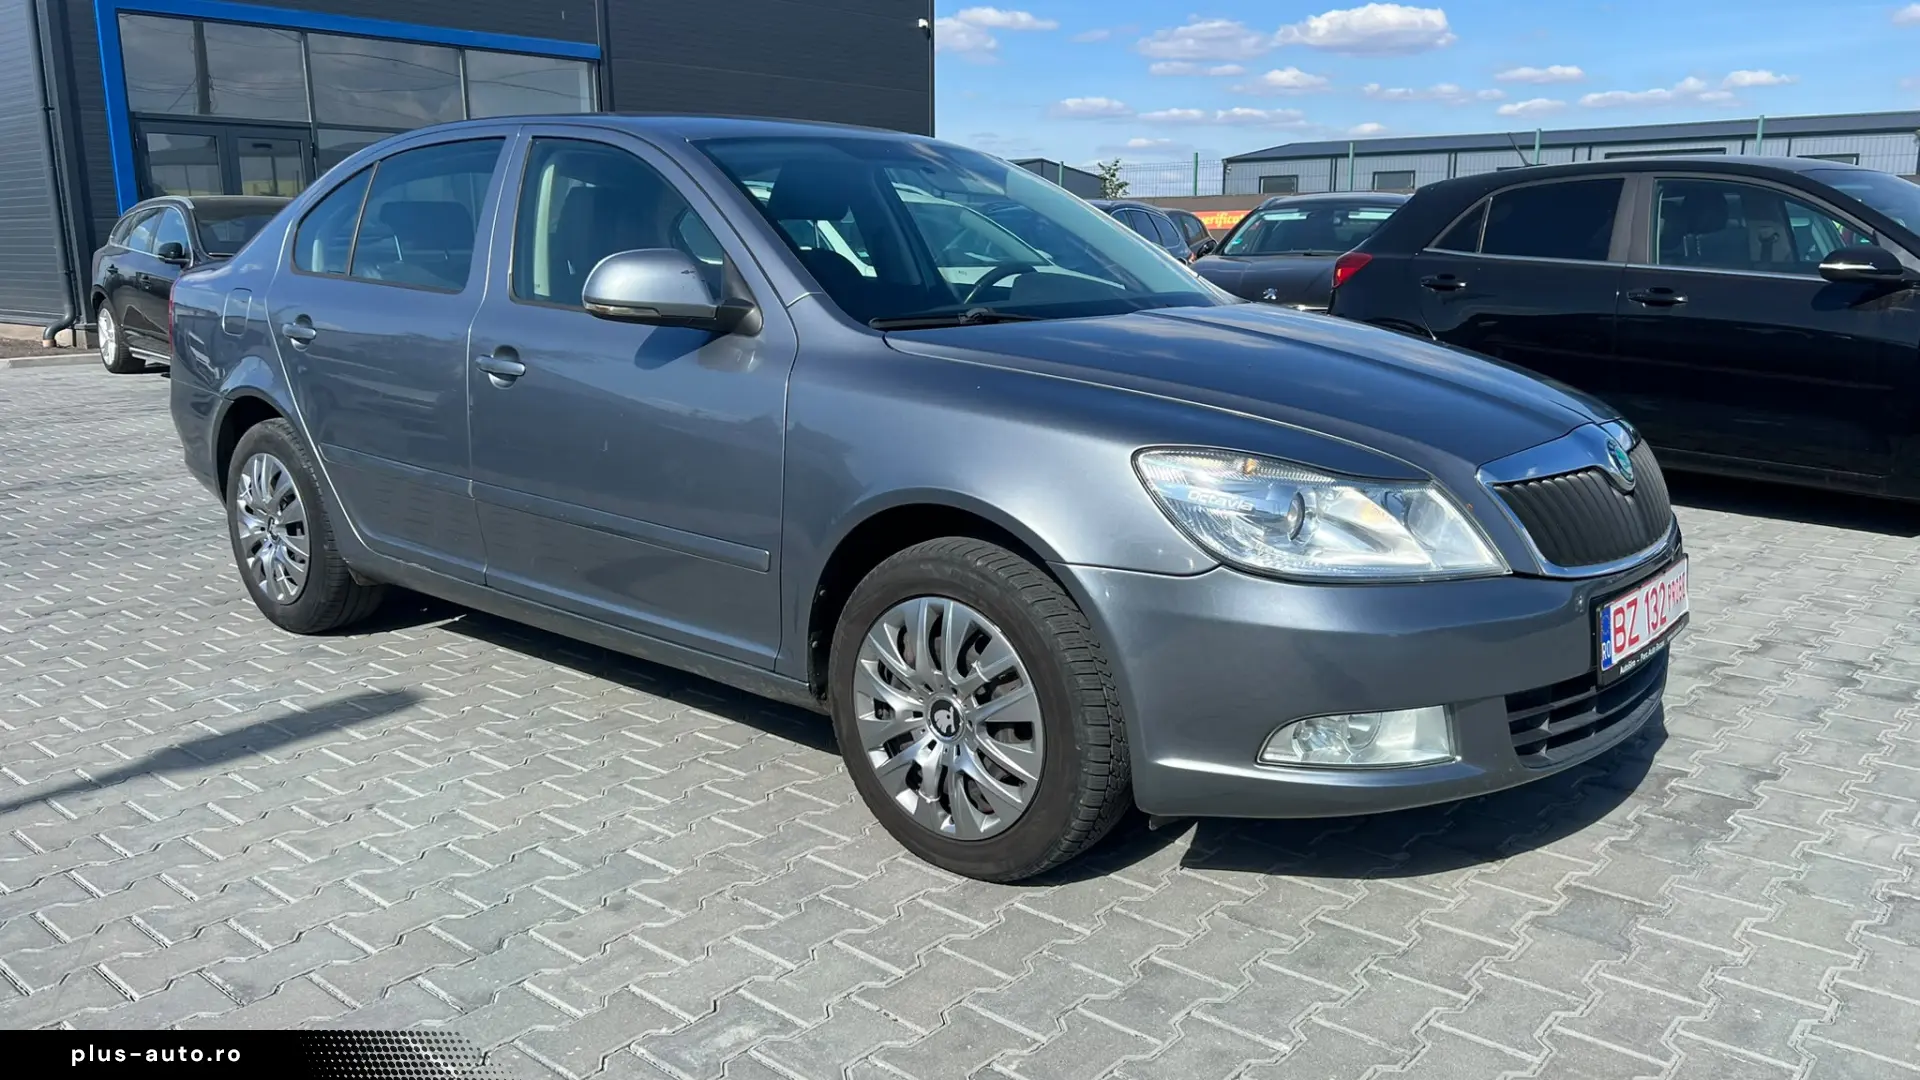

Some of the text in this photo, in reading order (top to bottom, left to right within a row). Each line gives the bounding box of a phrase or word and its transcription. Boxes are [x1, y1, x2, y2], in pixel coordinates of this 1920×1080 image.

[1613, 597, 1639, 654] BZ
[1644, 582, 1667, 635] 132
[1602, 640, 1611, 661] RO
